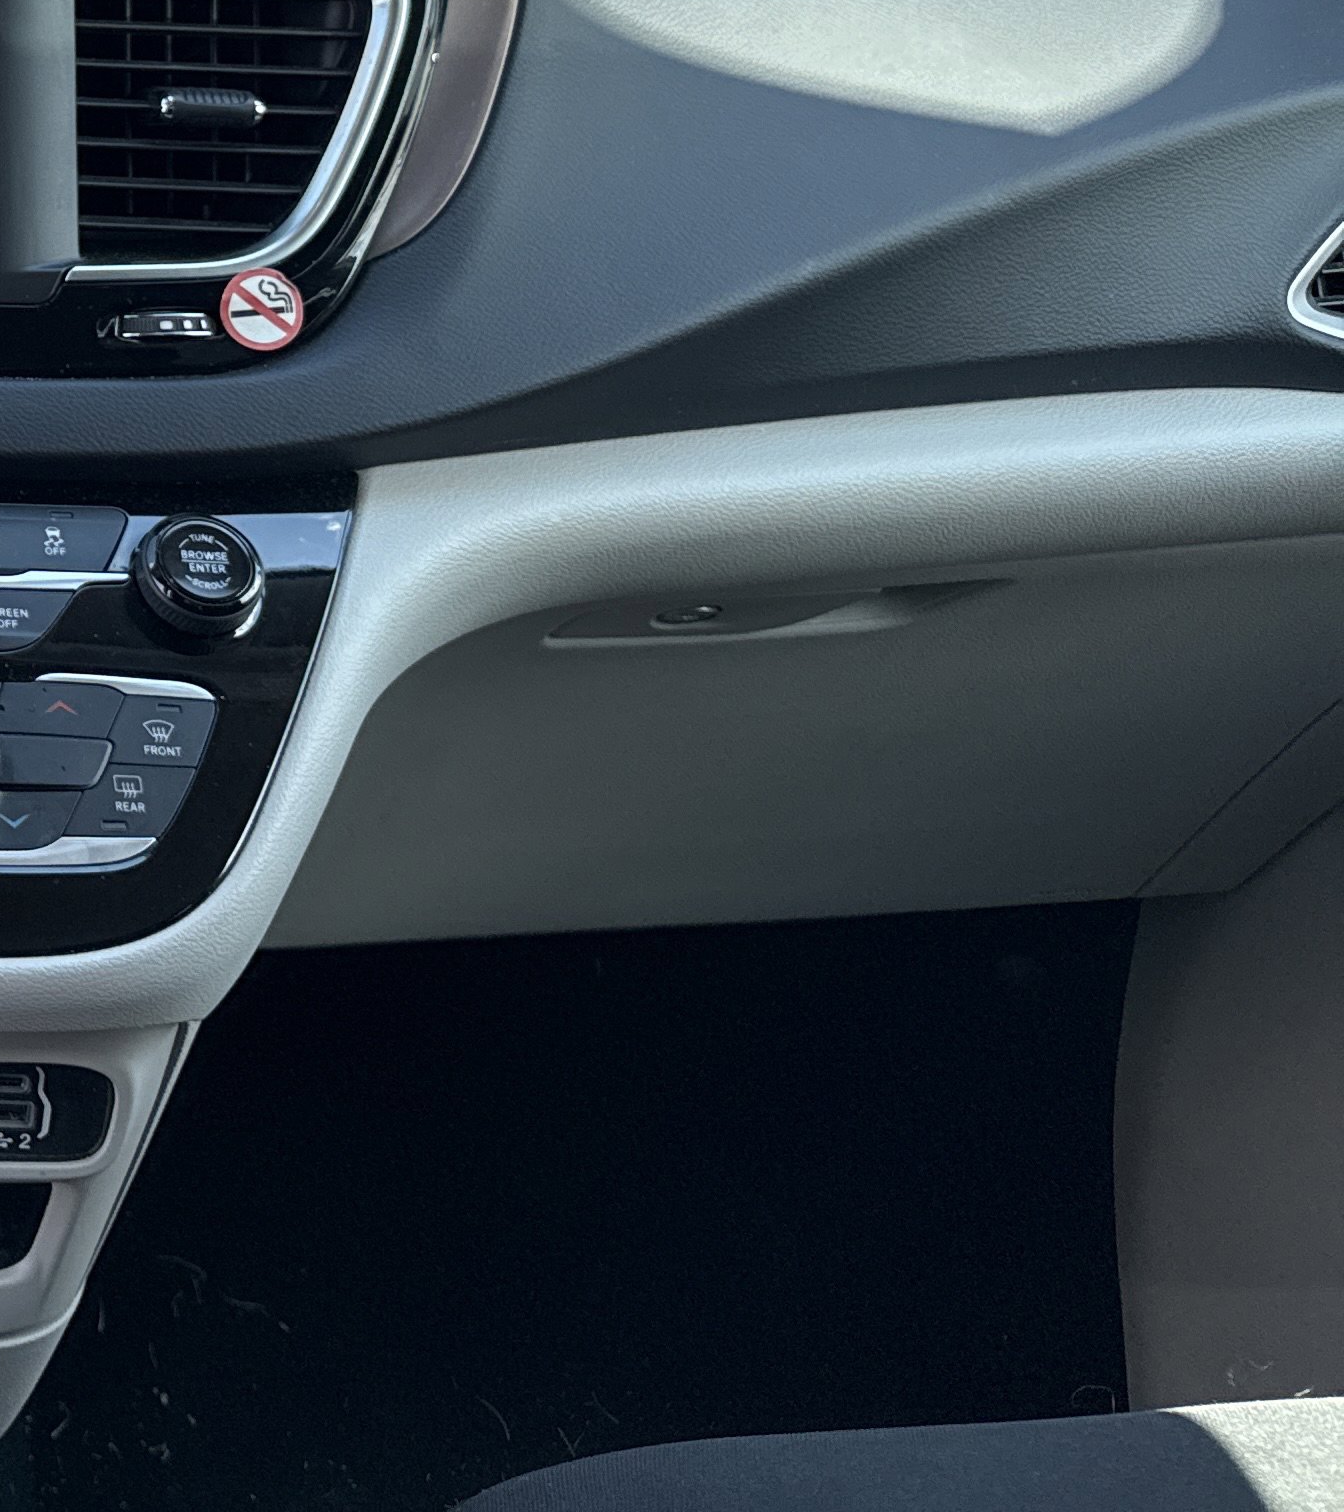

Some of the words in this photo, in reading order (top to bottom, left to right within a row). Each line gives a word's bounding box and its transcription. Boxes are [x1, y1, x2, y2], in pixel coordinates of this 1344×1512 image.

[188, 533, 215, 544] TUNE
[44, 546, 66, 556] OFF
[180, 549, 228, 561] BROWSE
[188, 562, 226, 574] ENTER
[192, 578, 229, 590] SCROLL
[144, 744, 182, 757] FRONT
[115, 801, 146, 813] REAR
[18, 1134, 31, 1149] 2
